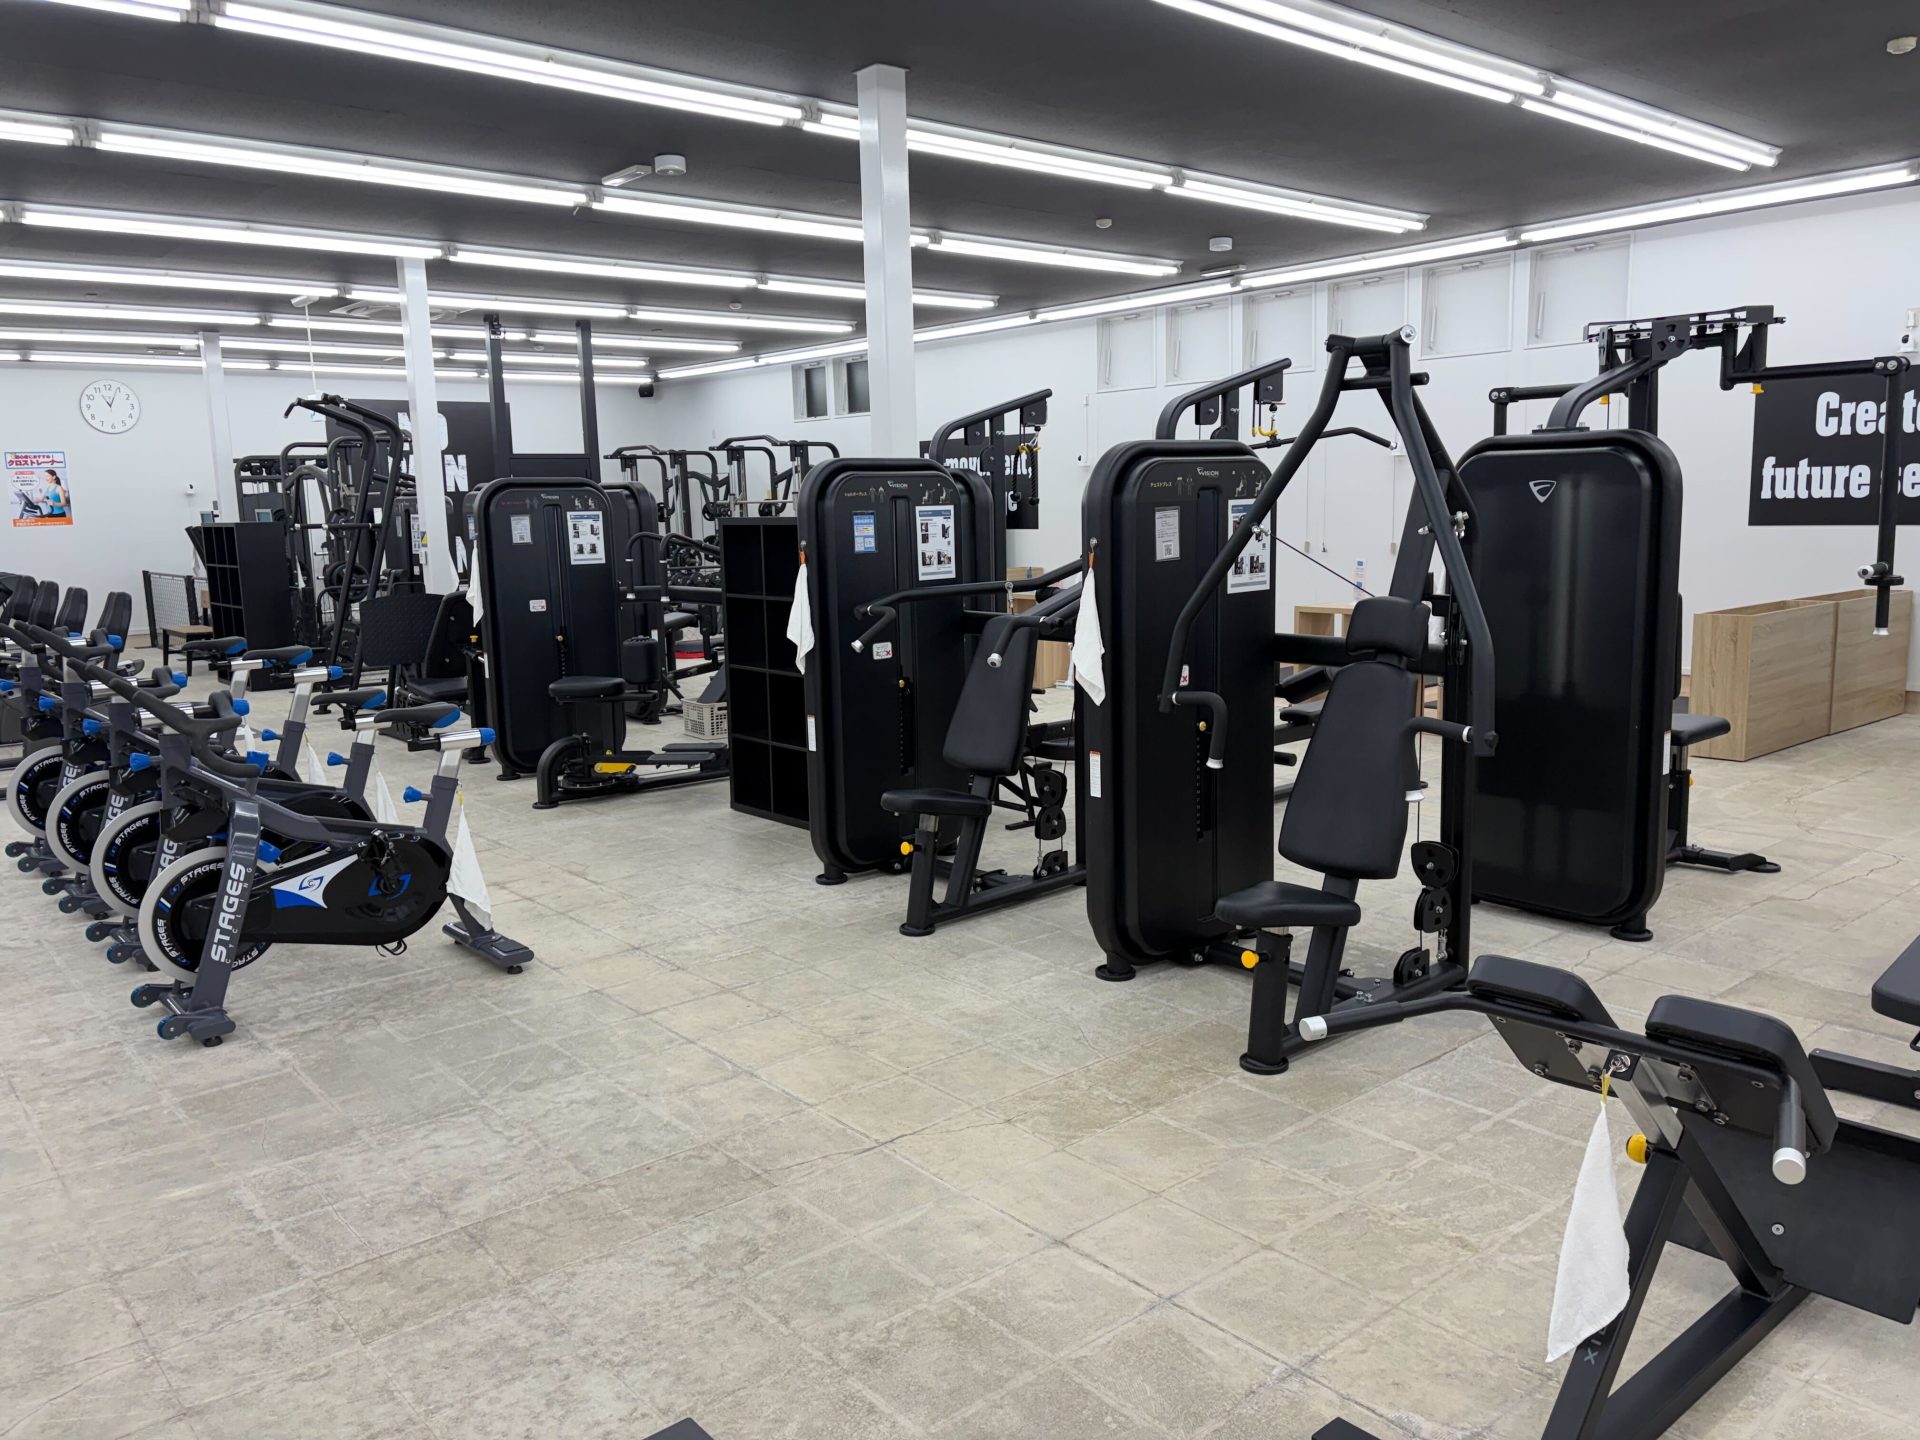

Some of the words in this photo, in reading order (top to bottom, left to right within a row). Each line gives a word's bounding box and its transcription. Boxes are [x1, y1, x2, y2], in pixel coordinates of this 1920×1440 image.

[1815, 389, 1920, 437] Cret
[8, 459, 64, 467] クロストレーナー
[1760, 456, 1871, 499] future
[115, 817, 149, 847] STAGES
[109, 876, 140, 905] STAGES
[180, 862, 225, 886] STAGES
[211, 862, 246, 963] STAGES
[225, 867, 253, 964] CYCLING
[157, 918, 181, 958] STAGES
